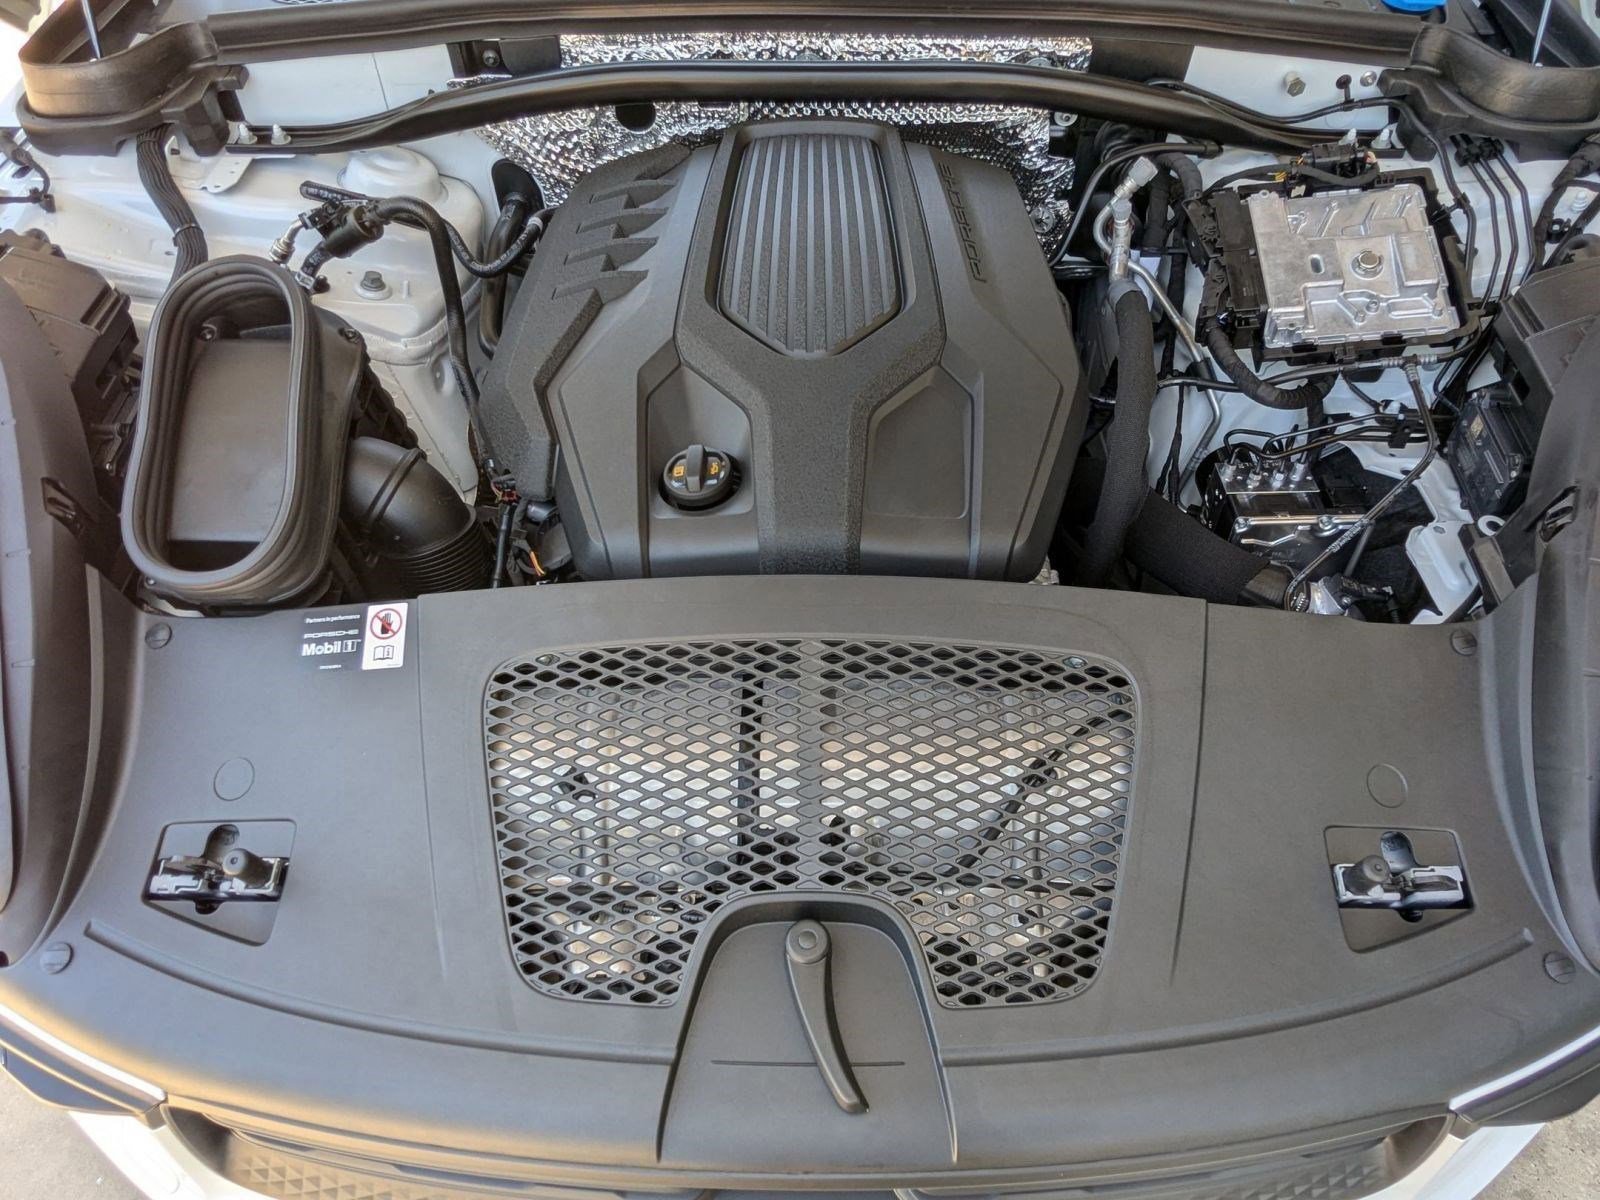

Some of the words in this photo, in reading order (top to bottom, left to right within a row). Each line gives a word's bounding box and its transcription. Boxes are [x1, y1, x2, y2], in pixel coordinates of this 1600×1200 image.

[938, 161, 987, 284] PORSCHE
[303, 629, 360, 639] PORSCHE
[301, 641, 342, 657] Mobil
